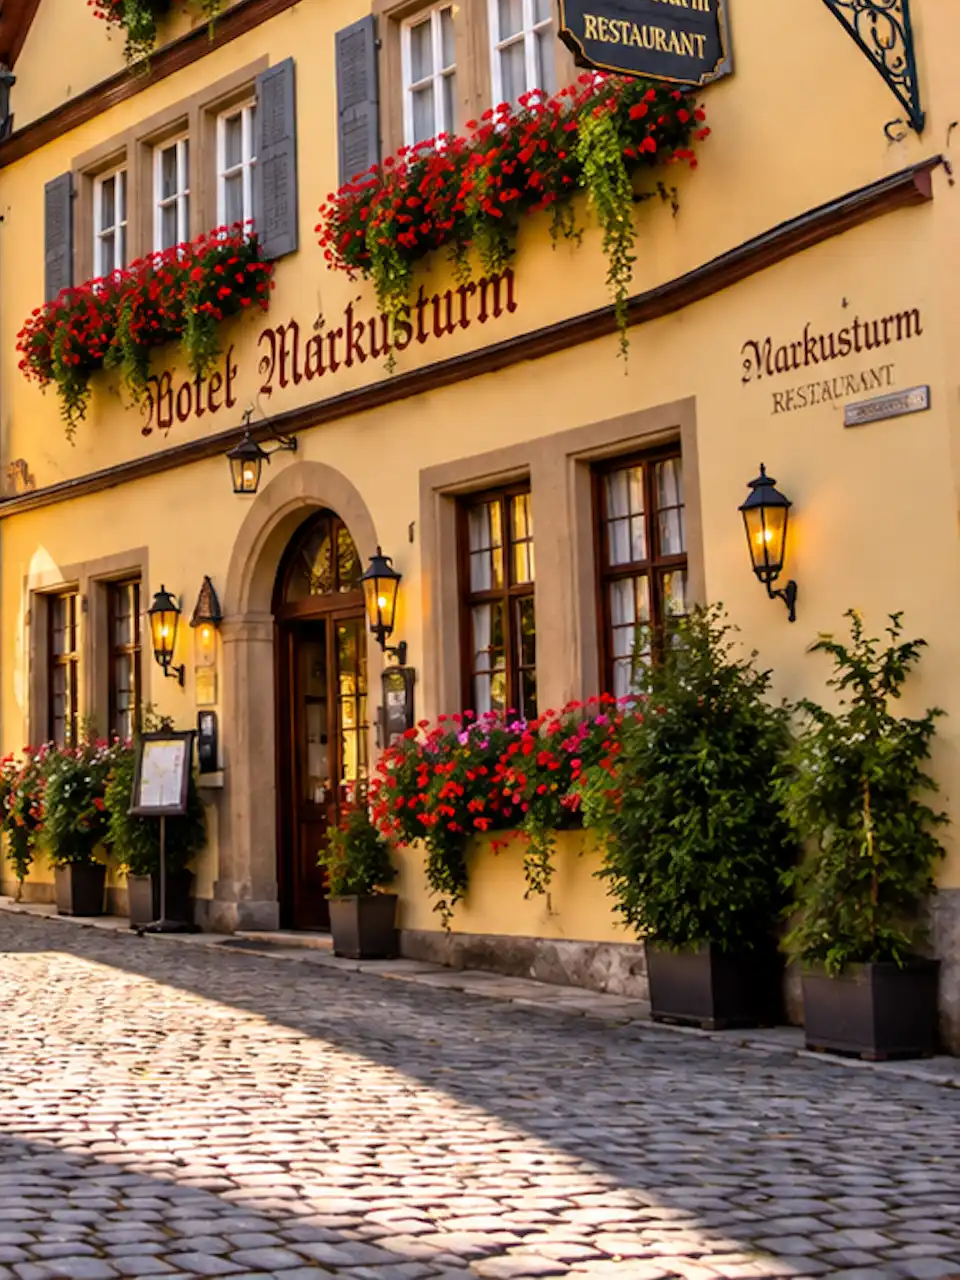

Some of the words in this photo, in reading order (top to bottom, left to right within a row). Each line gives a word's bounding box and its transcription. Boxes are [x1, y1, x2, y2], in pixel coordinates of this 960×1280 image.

[583, 14, 707, 59] RESTAURANT
[140, 344, 238, 437] Hotel
[257, 268, 519, 399] Markusturm
[741, 307, 923, 384] Markusturm
[771, 364, 895, 415] RESTAURANT
